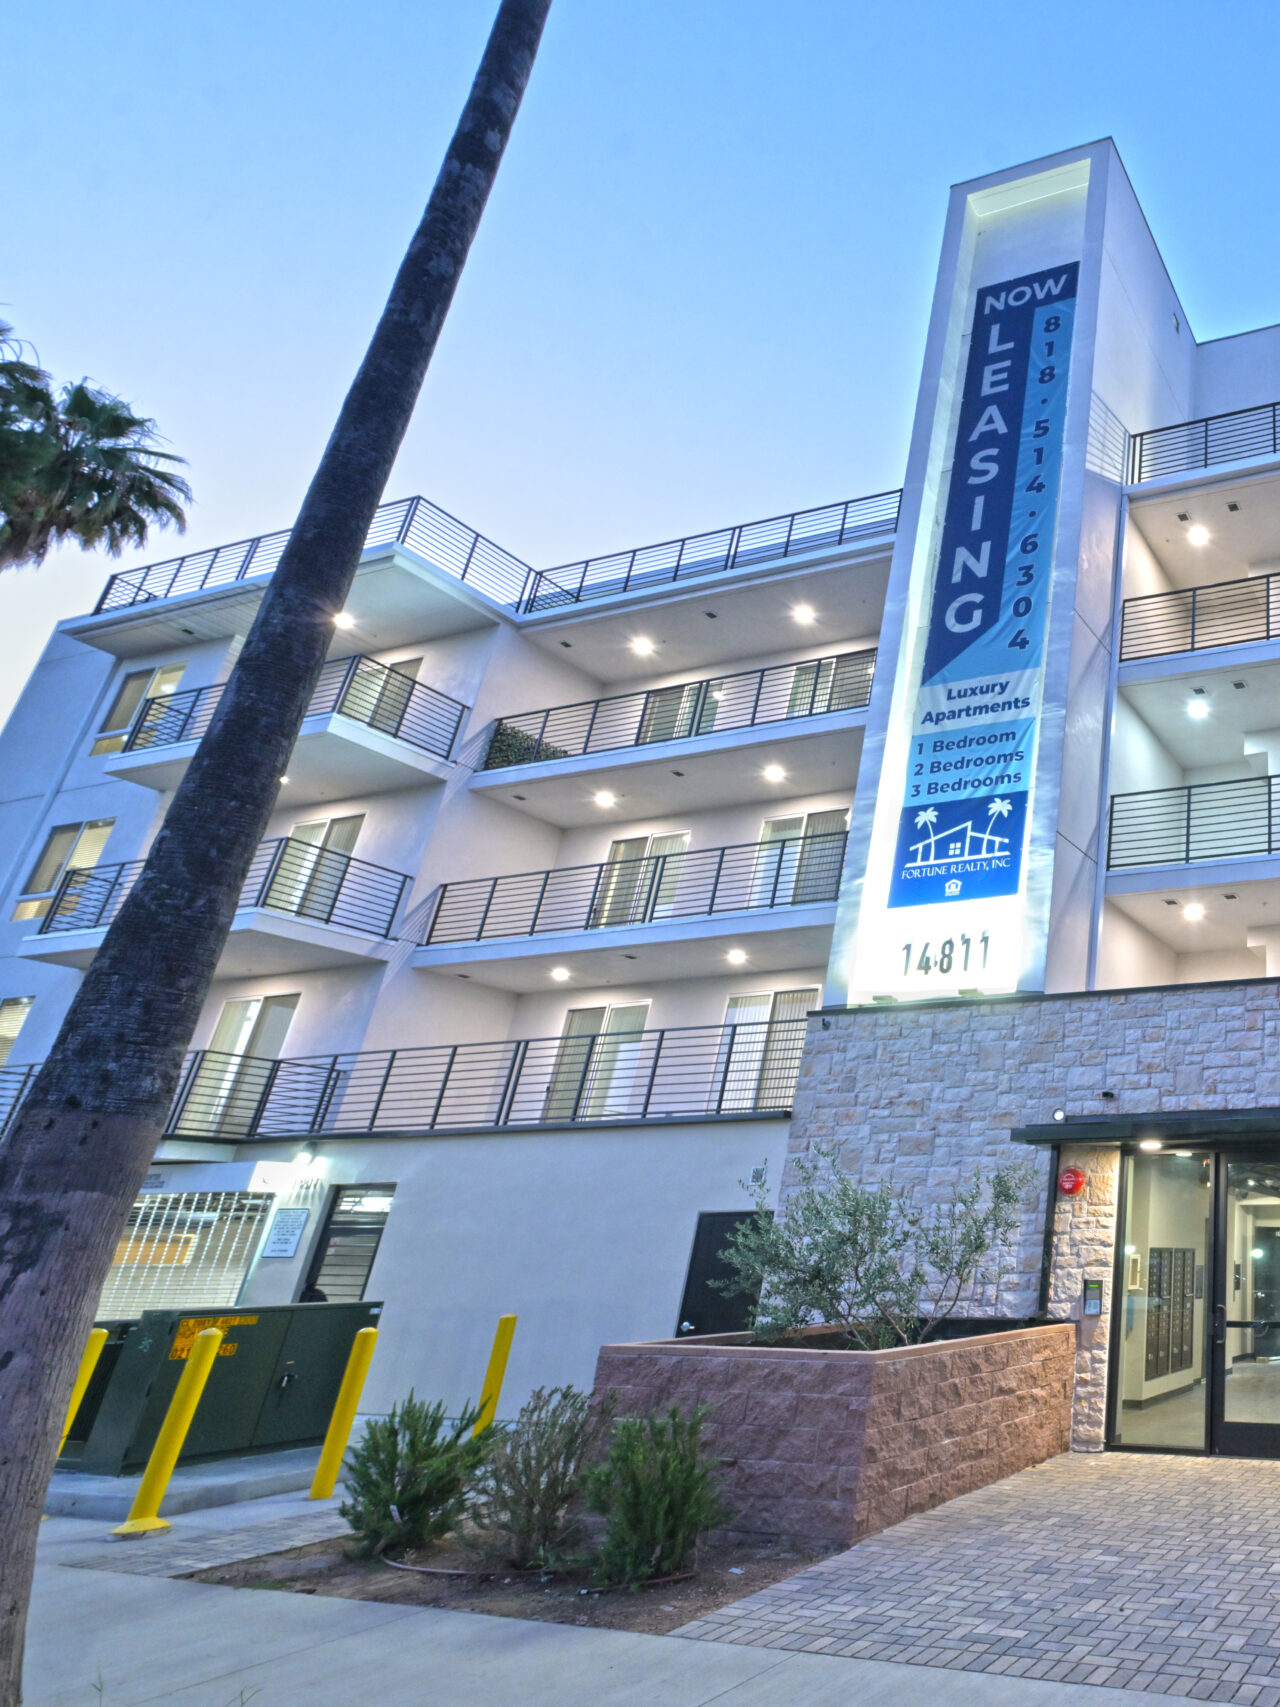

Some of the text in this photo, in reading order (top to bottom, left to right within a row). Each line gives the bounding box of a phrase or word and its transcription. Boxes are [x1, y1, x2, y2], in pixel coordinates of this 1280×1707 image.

[984, 274, 1068, 315] NOW
[944, 323, 1016, 634] LEASING
[946, 681, 1010, 701] Luxury
[921, 697, 1031, 725] Apartments
[917, 731, 1017, 755] 1 Bedroom
[914, 750, 1025, 776] 2 Bedrooms
[911, 772, 1022, 798] 3 Bedrooms
[901, 857, 1011, 880] FORTUNE REALTY, INC
[902, 934, 990, 977] 14811
